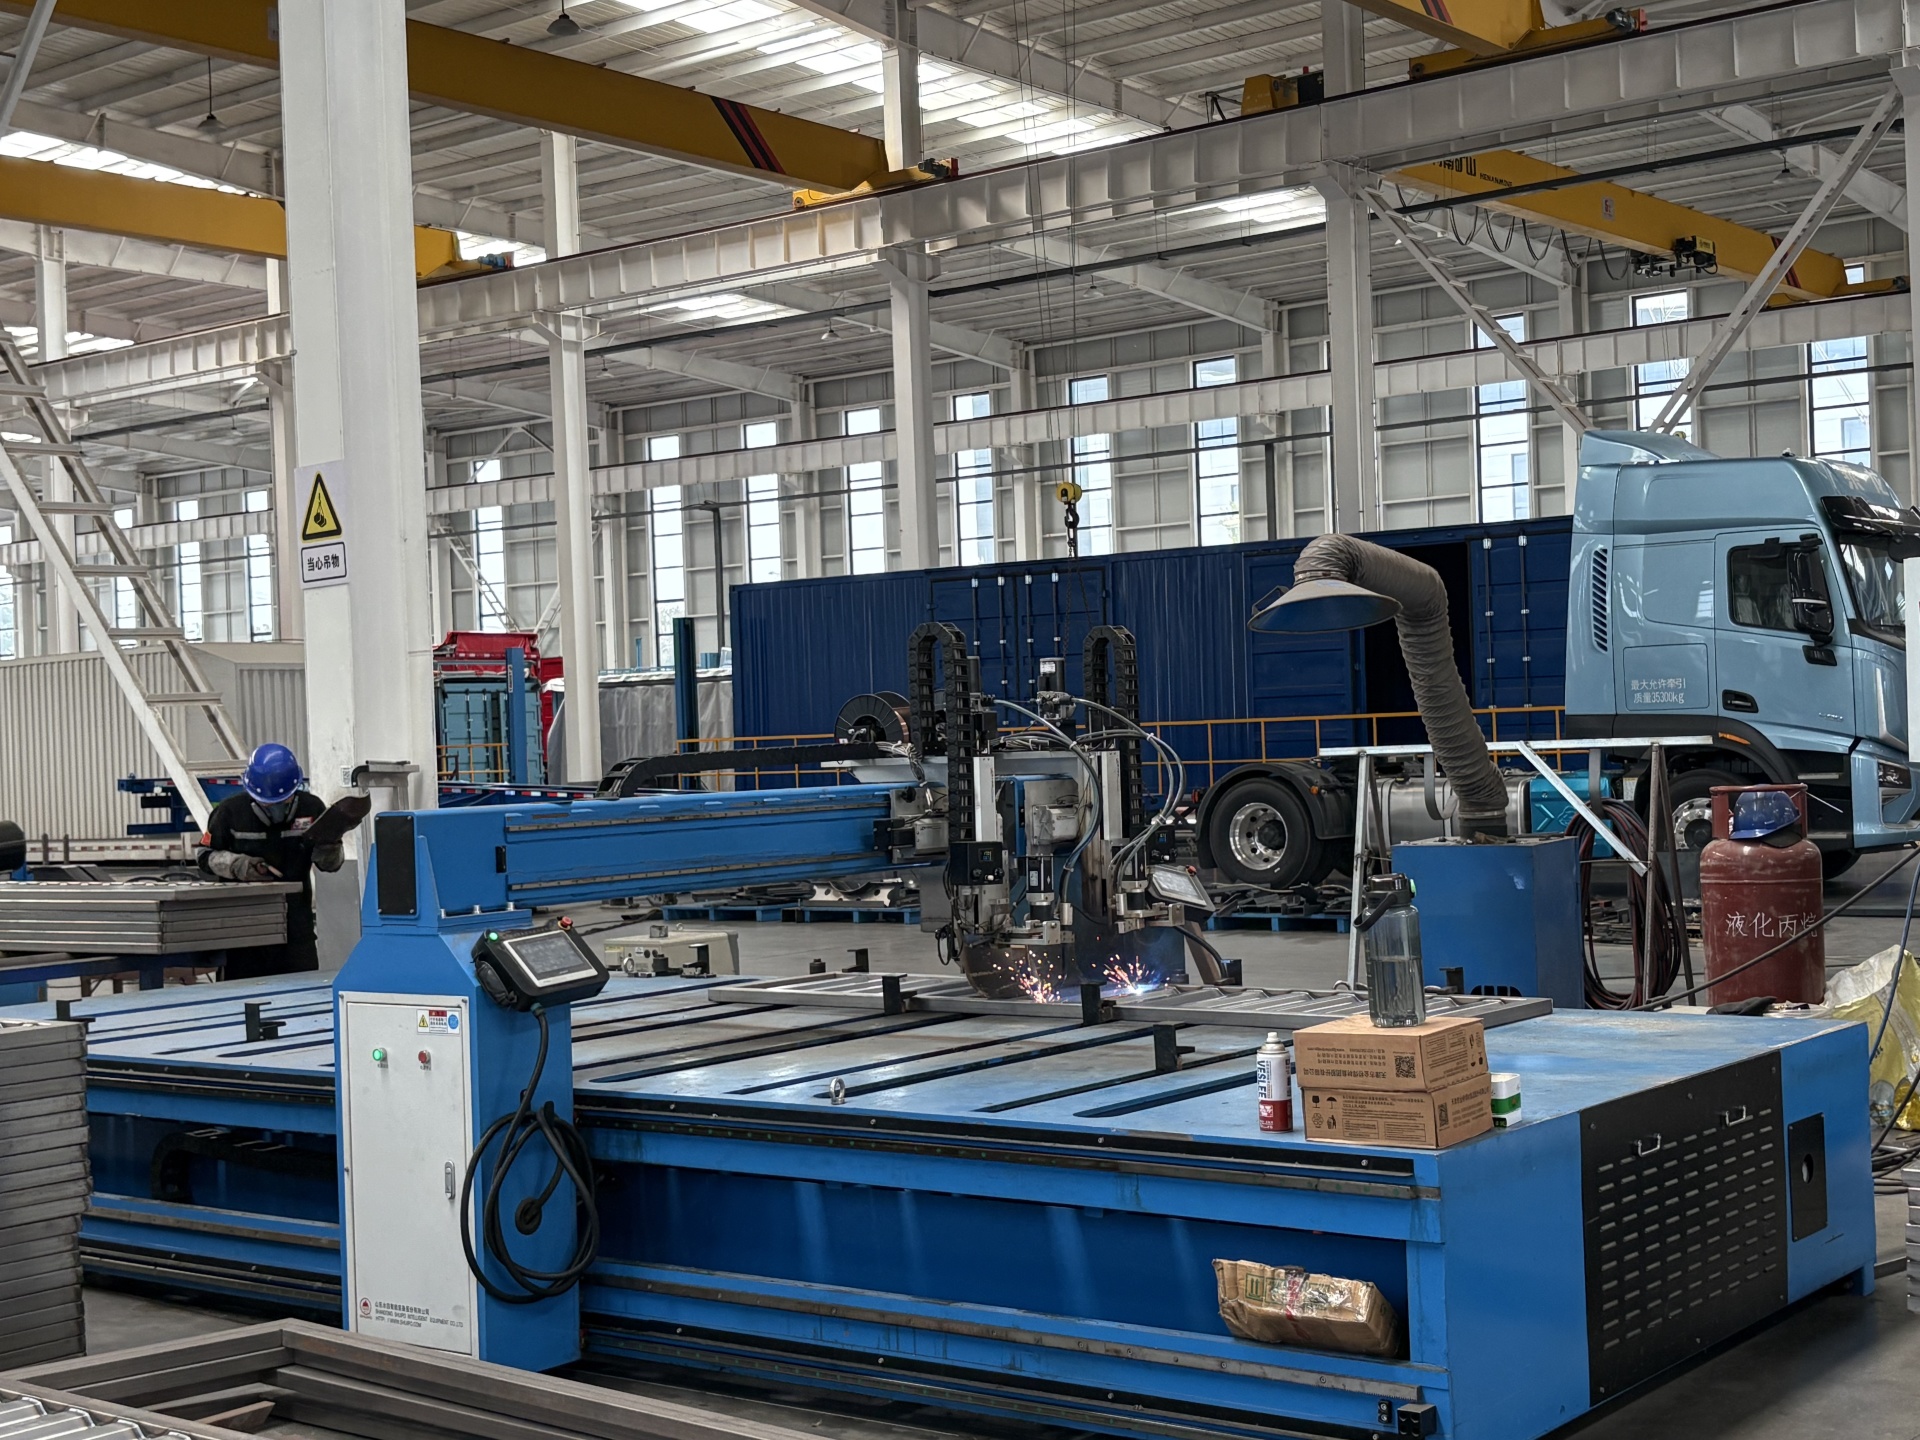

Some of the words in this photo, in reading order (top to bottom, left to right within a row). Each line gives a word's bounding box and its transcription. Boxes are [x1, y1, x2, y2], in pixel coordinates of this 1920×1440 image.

[307, 553, 340, 572] 当心吊物
[1631, 677, 1686, 691] 最大允许牵引
[1633, 691, 1685, 704] 质量35300kg
[1725, 911, 1818, 939] 液化丙烷
